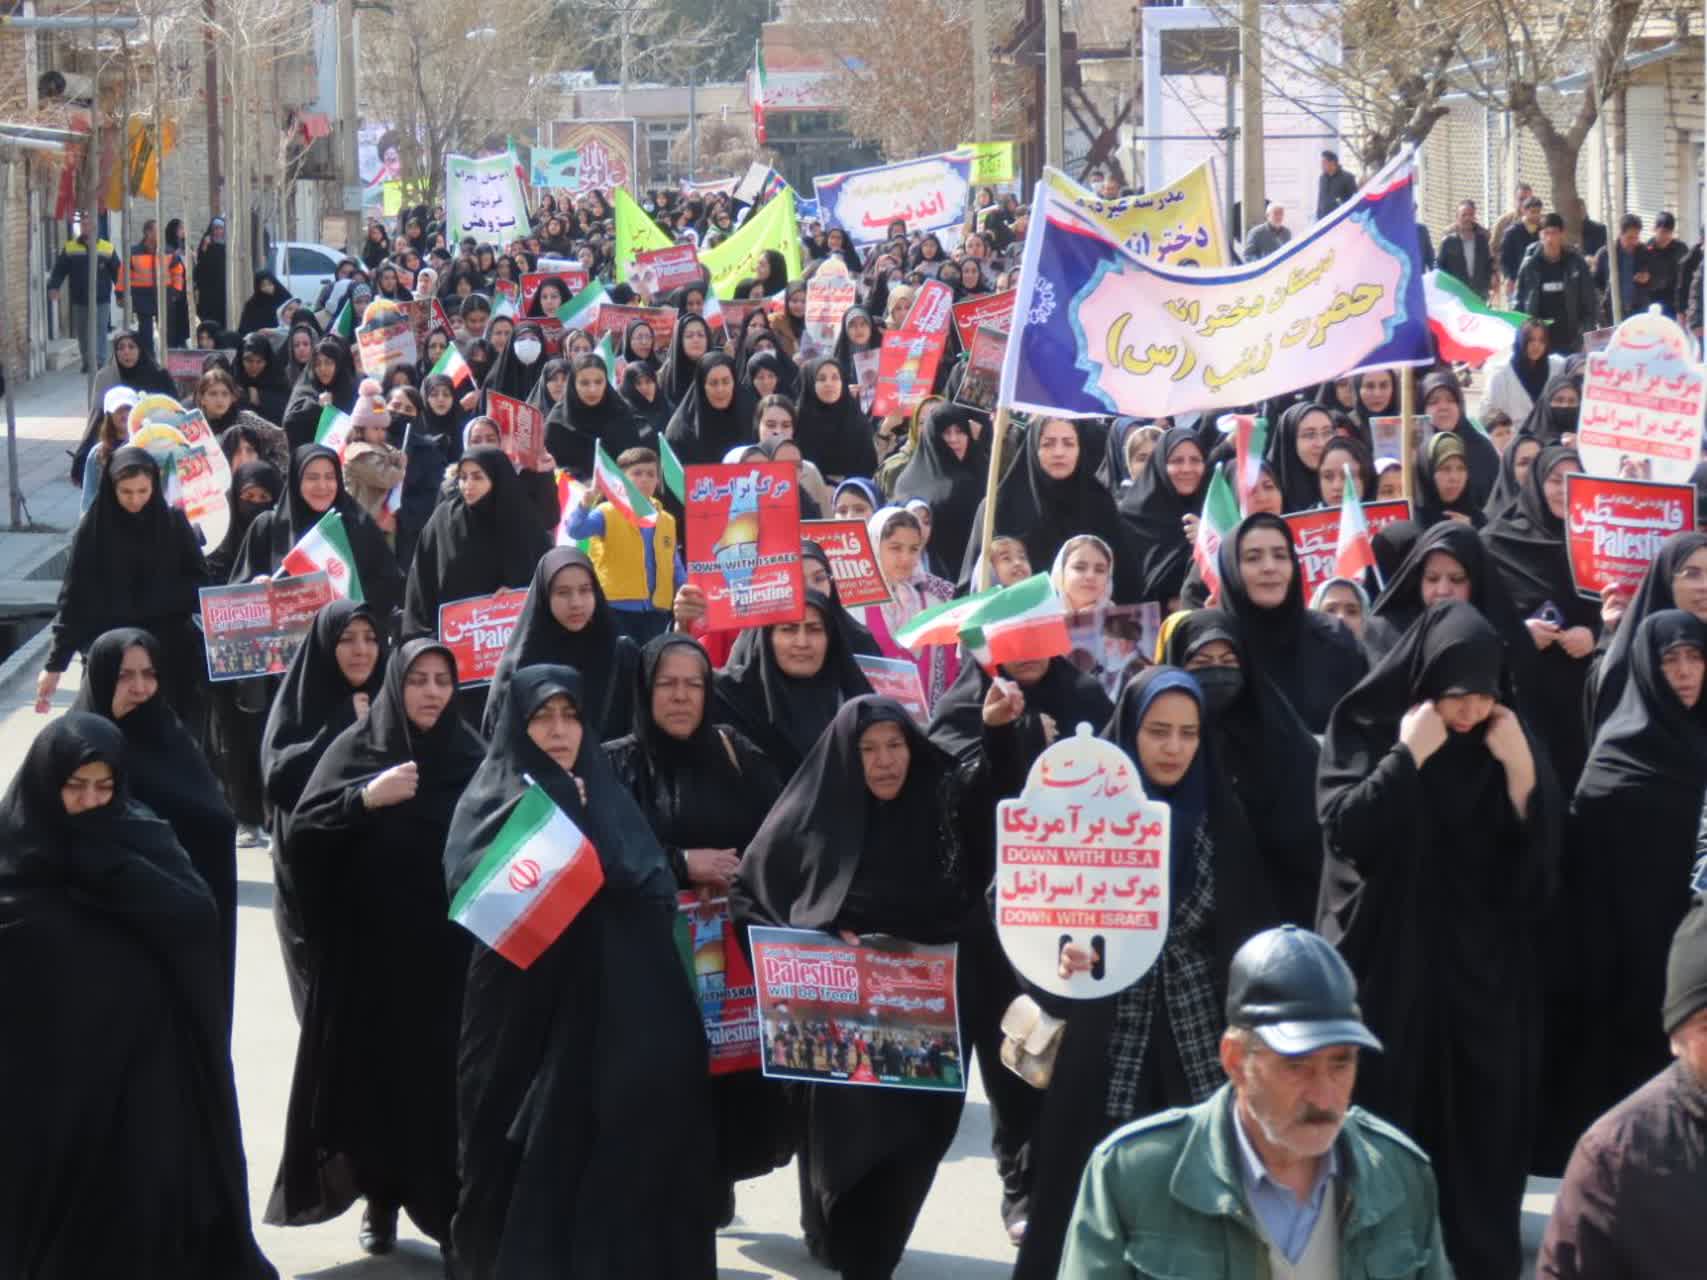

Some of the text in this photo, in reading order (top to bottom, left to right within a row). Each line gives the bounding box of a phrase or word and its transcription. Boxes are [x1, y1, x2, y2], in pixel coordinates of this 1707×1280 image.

[862, 191, 945, 228] اندیشه
[1134, 191, 1185, 211] مدرسه
[1105, 281, 1384, 394] حضرت زینب (س)
[1570, 499, 1684, 534] فلسطین
[724, 557, 756, 571] WITH
[707, 571, 791, 600] فلسطین
[730, 584, 793, 607] Palestine
[1002, 804, 1162, 845] مرگ بر آمریکا
[1007, 847, 1154, 866] DOWN WITH U.S.A
[1001, 868, 1161, 906] مرگ بر اسرائیل
[1004, 909, 1153, 927] DOWN WITH ISRAEL
[762, 956, 859, 991] Palestine
[767, 981, 859, 1004] will be freed
